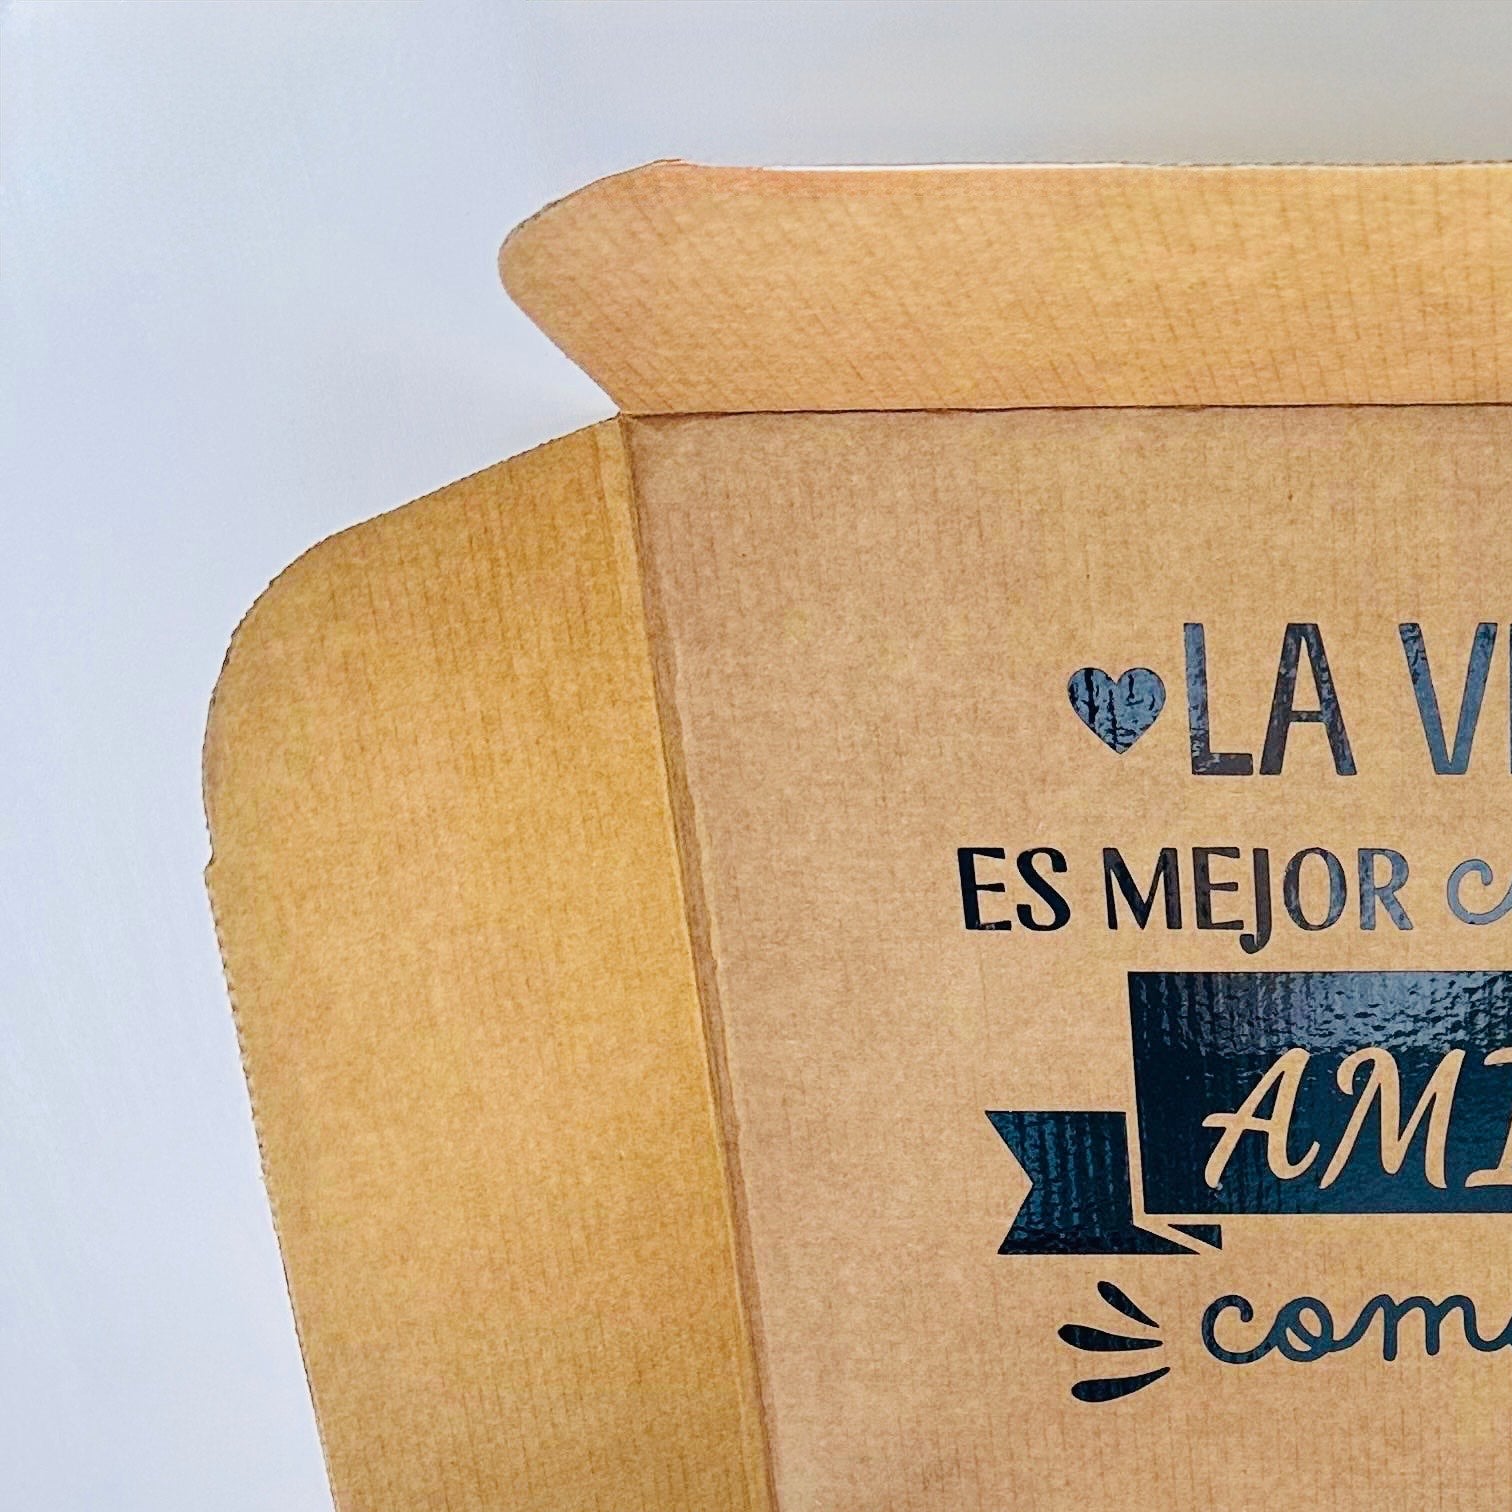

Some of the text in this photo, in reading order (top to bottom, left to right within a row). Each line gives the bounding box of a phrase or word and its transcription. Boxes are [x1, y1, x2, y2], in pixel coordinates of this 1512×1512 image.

[1183, 621, 1358, 776] LA
[956, 846, 1071, 931] ES
[1103, 846, 1414, 954] MEJOR
